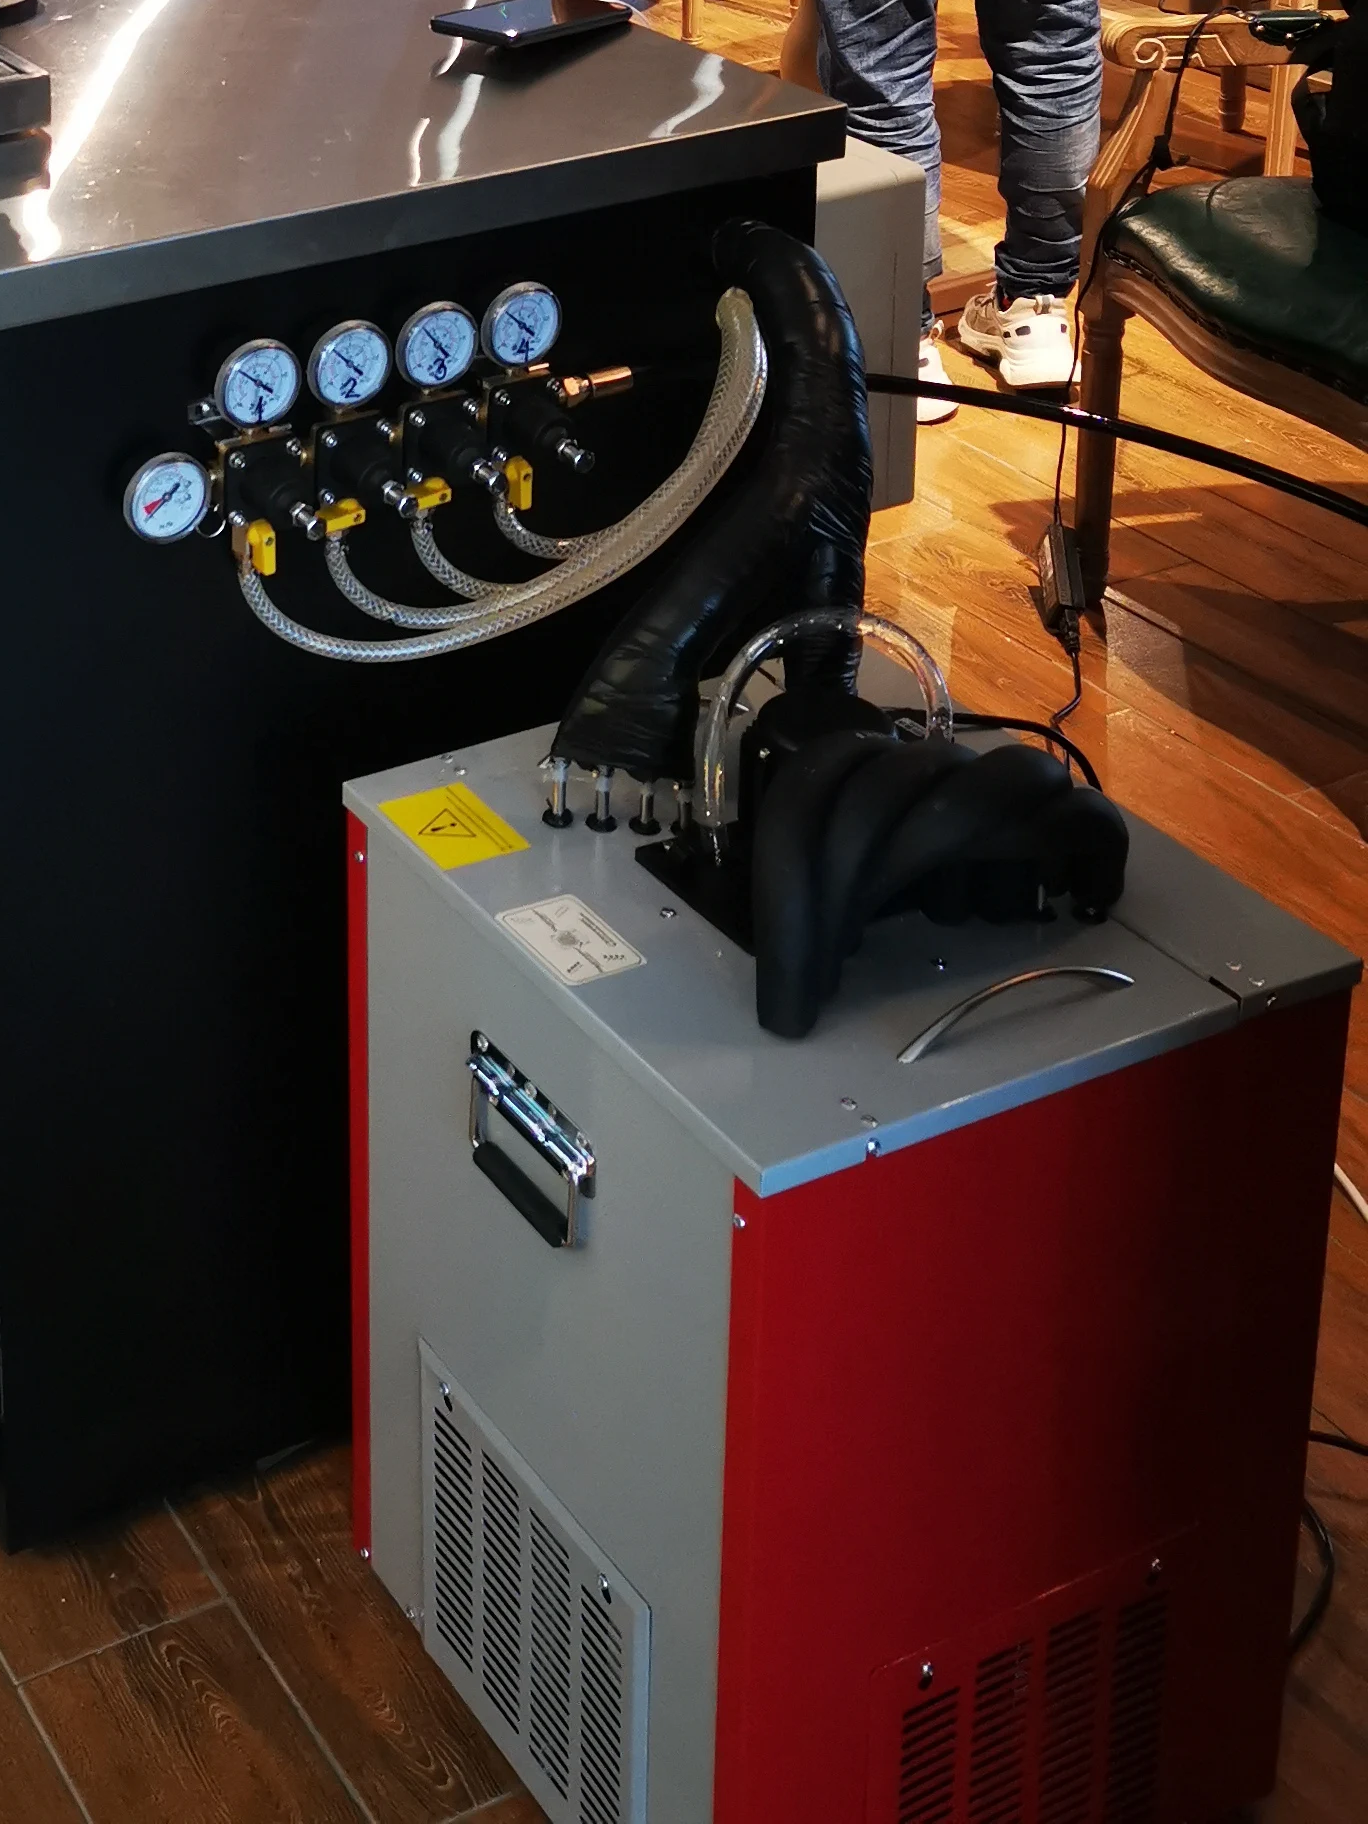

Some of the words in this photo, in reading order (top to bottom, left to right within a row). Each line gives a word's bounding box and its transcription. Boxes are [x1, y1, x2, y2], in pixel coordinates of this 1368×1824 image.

[515, 337, 535, 363] 4
[433, 357, 448, 381] 3
[340, 376, 361, 399] 2
